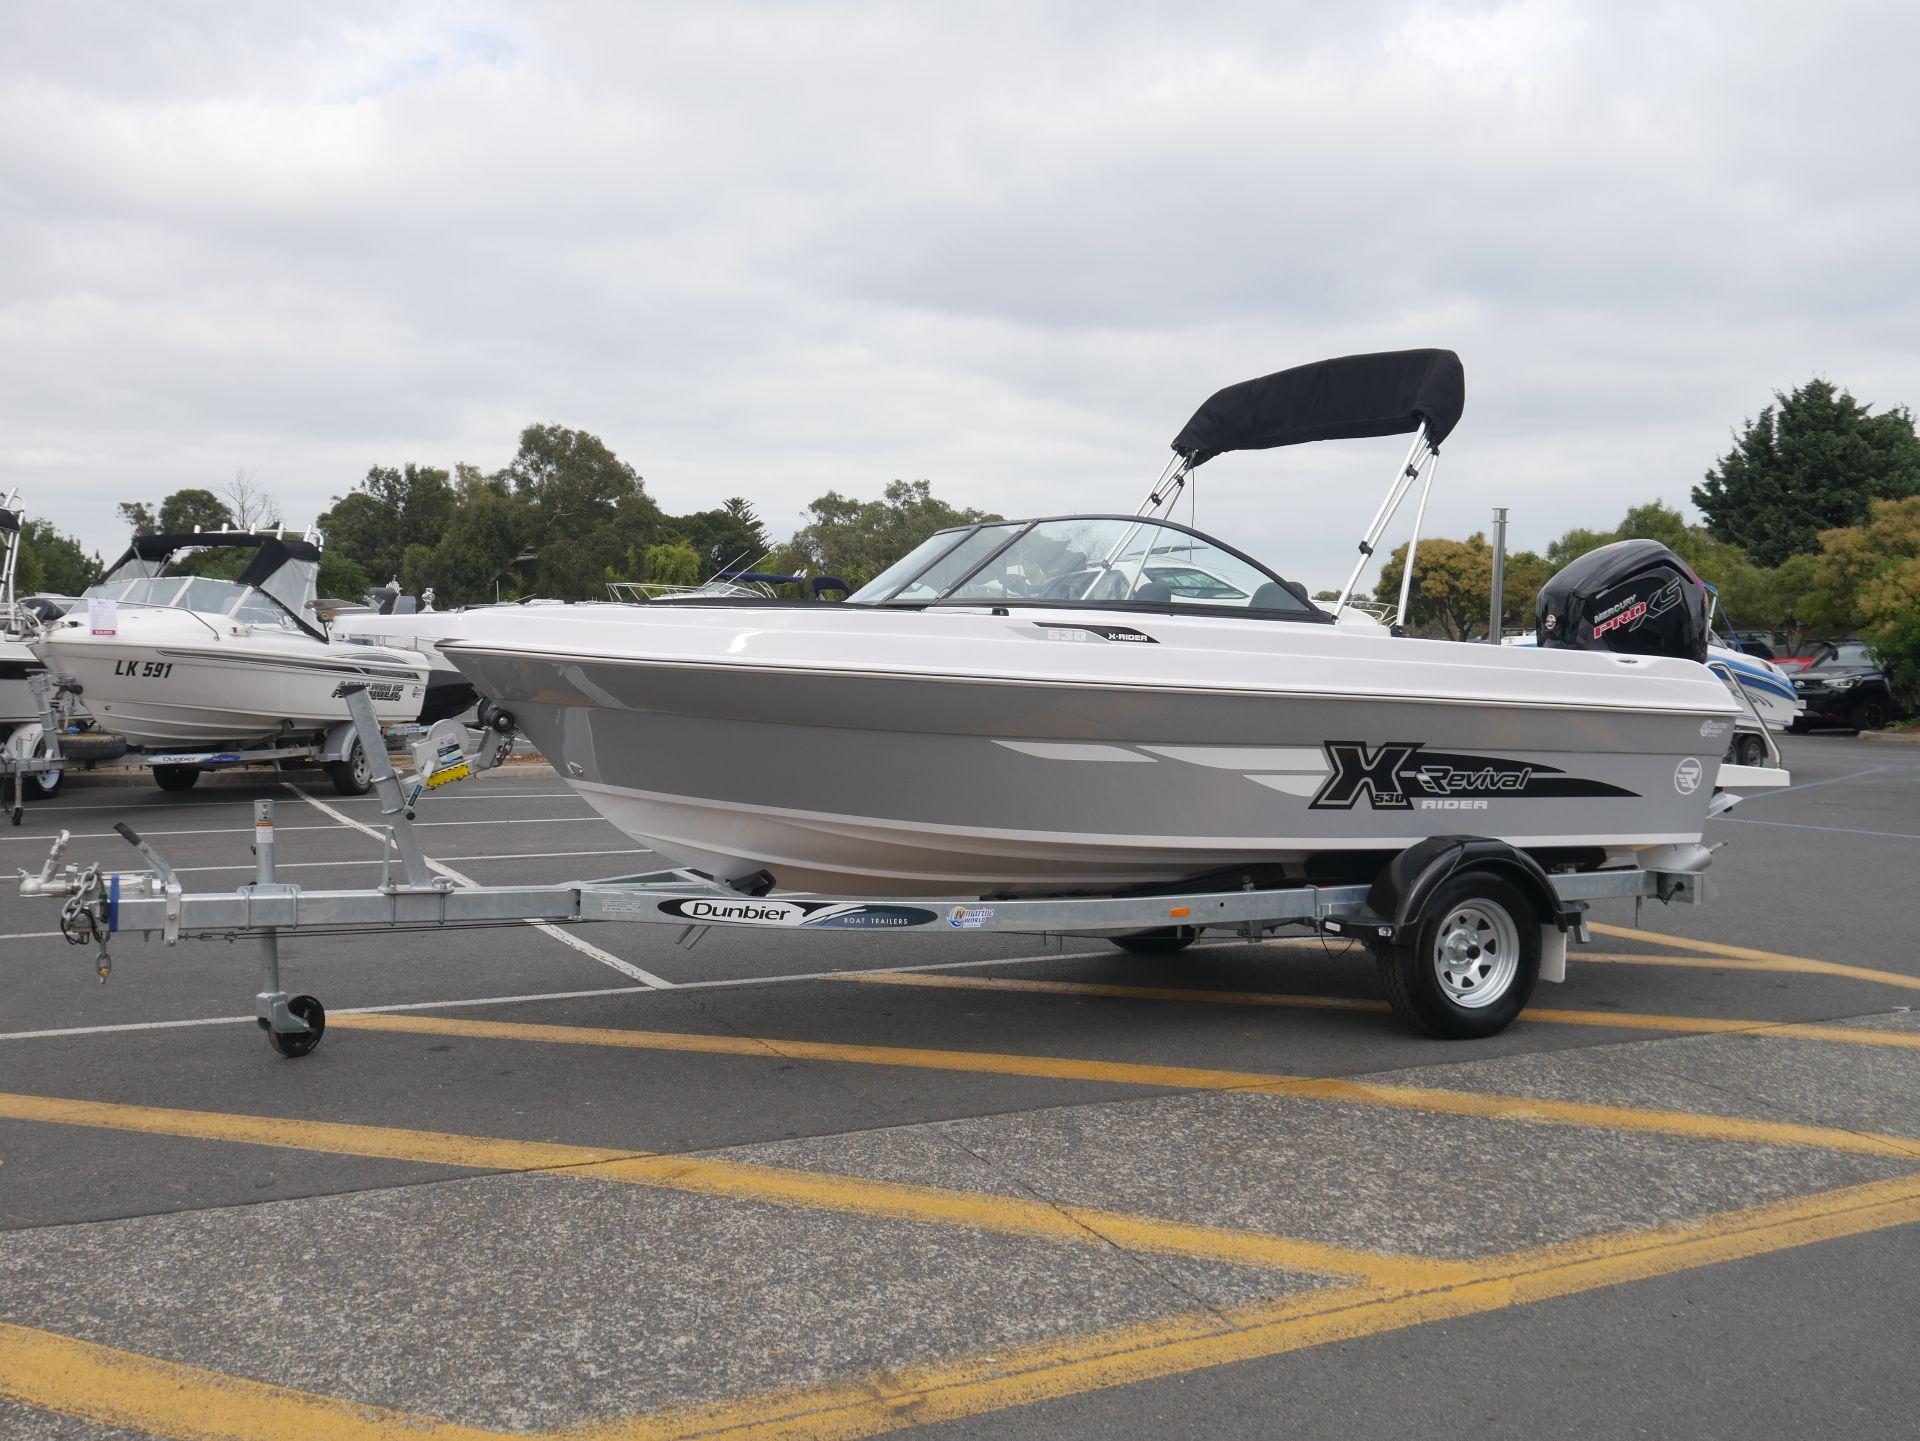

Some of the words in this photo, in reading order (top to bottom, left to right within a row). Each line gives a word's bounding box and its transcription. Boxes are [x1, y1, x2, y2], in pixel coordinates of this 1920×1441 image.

[1593, 601, 1647, 639] PRO
[1628, 576, 1683, 632] XS
[1593, 594, 1637, 624] MERCURY
[1047, 629, 1087, 642] 530
[1107, 633, 1148, 642] X-RIDER
[114, 660, 139, 677] LK
[142, 661, 173, 679] 591
[1308, 741, 1426, 810] X
[1416, 765, 1532, 795] Revival
[1373, 793, 1405, 804] 530
[1421, 800, 1489, 810] RIDER
[692, 902, 791, 921] Dunbier
[843, 916, 866, 925] BOAT
[870, 917, 909, 925] TRAILERS
